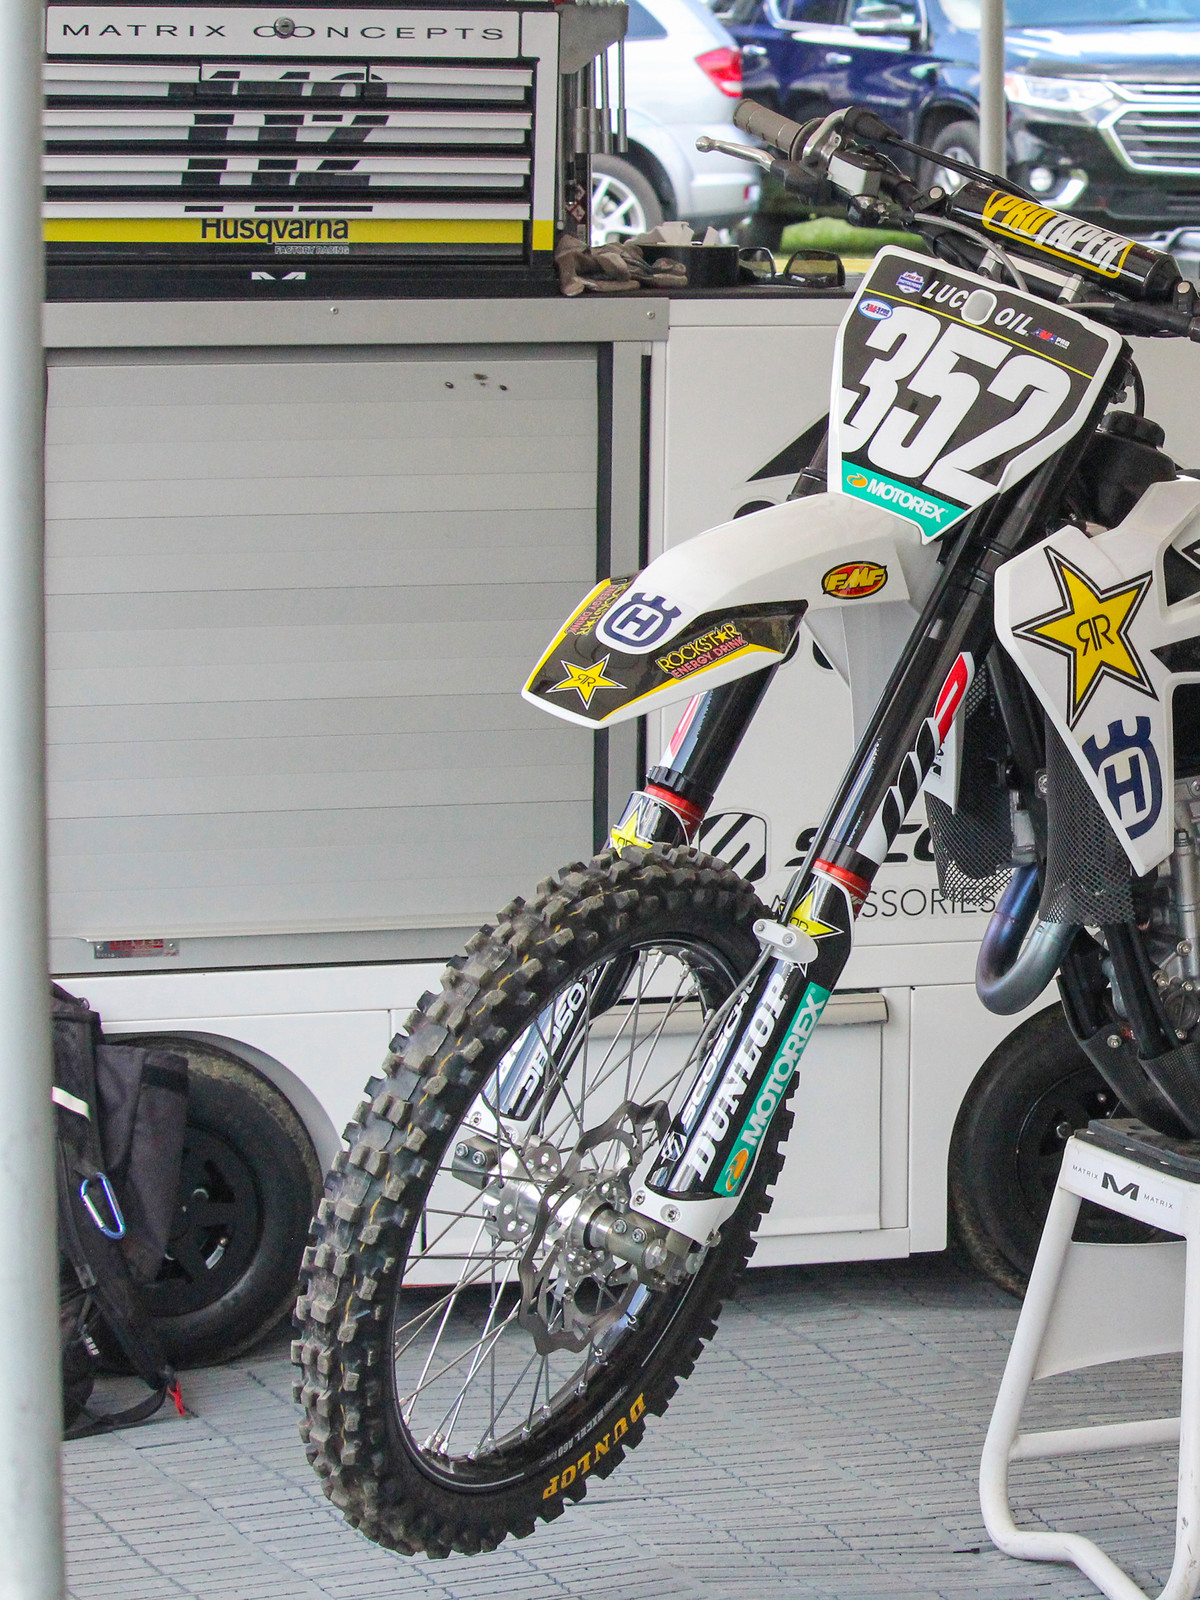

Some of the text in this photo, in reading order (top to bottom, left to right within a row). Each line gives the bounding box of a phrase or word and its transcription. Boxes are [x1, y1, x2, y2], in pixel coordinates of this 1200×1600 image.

[61, 24, 505, 40] MATRIX CONCEPTS
[201, 218, 350, 245] Husqvarna
[994, 308, 1033, 336] OIL
[842, 305, 1072, 507] 352
[867, 479, 945, 523] MOTOREX
[826, 567, 885, 592] FMF
[672, 636, 748, 678] ENERGY DRINK
[692, 973, 787, 1182] DUNLOP
[741, 993, 826, 1146] MOTOREX
[1072, 1164, 1099, 1181] MATRIX
[1143, 1193, 1174, 1210] MATRIX
[542, 1393, 646, 1500] DUNLOP
